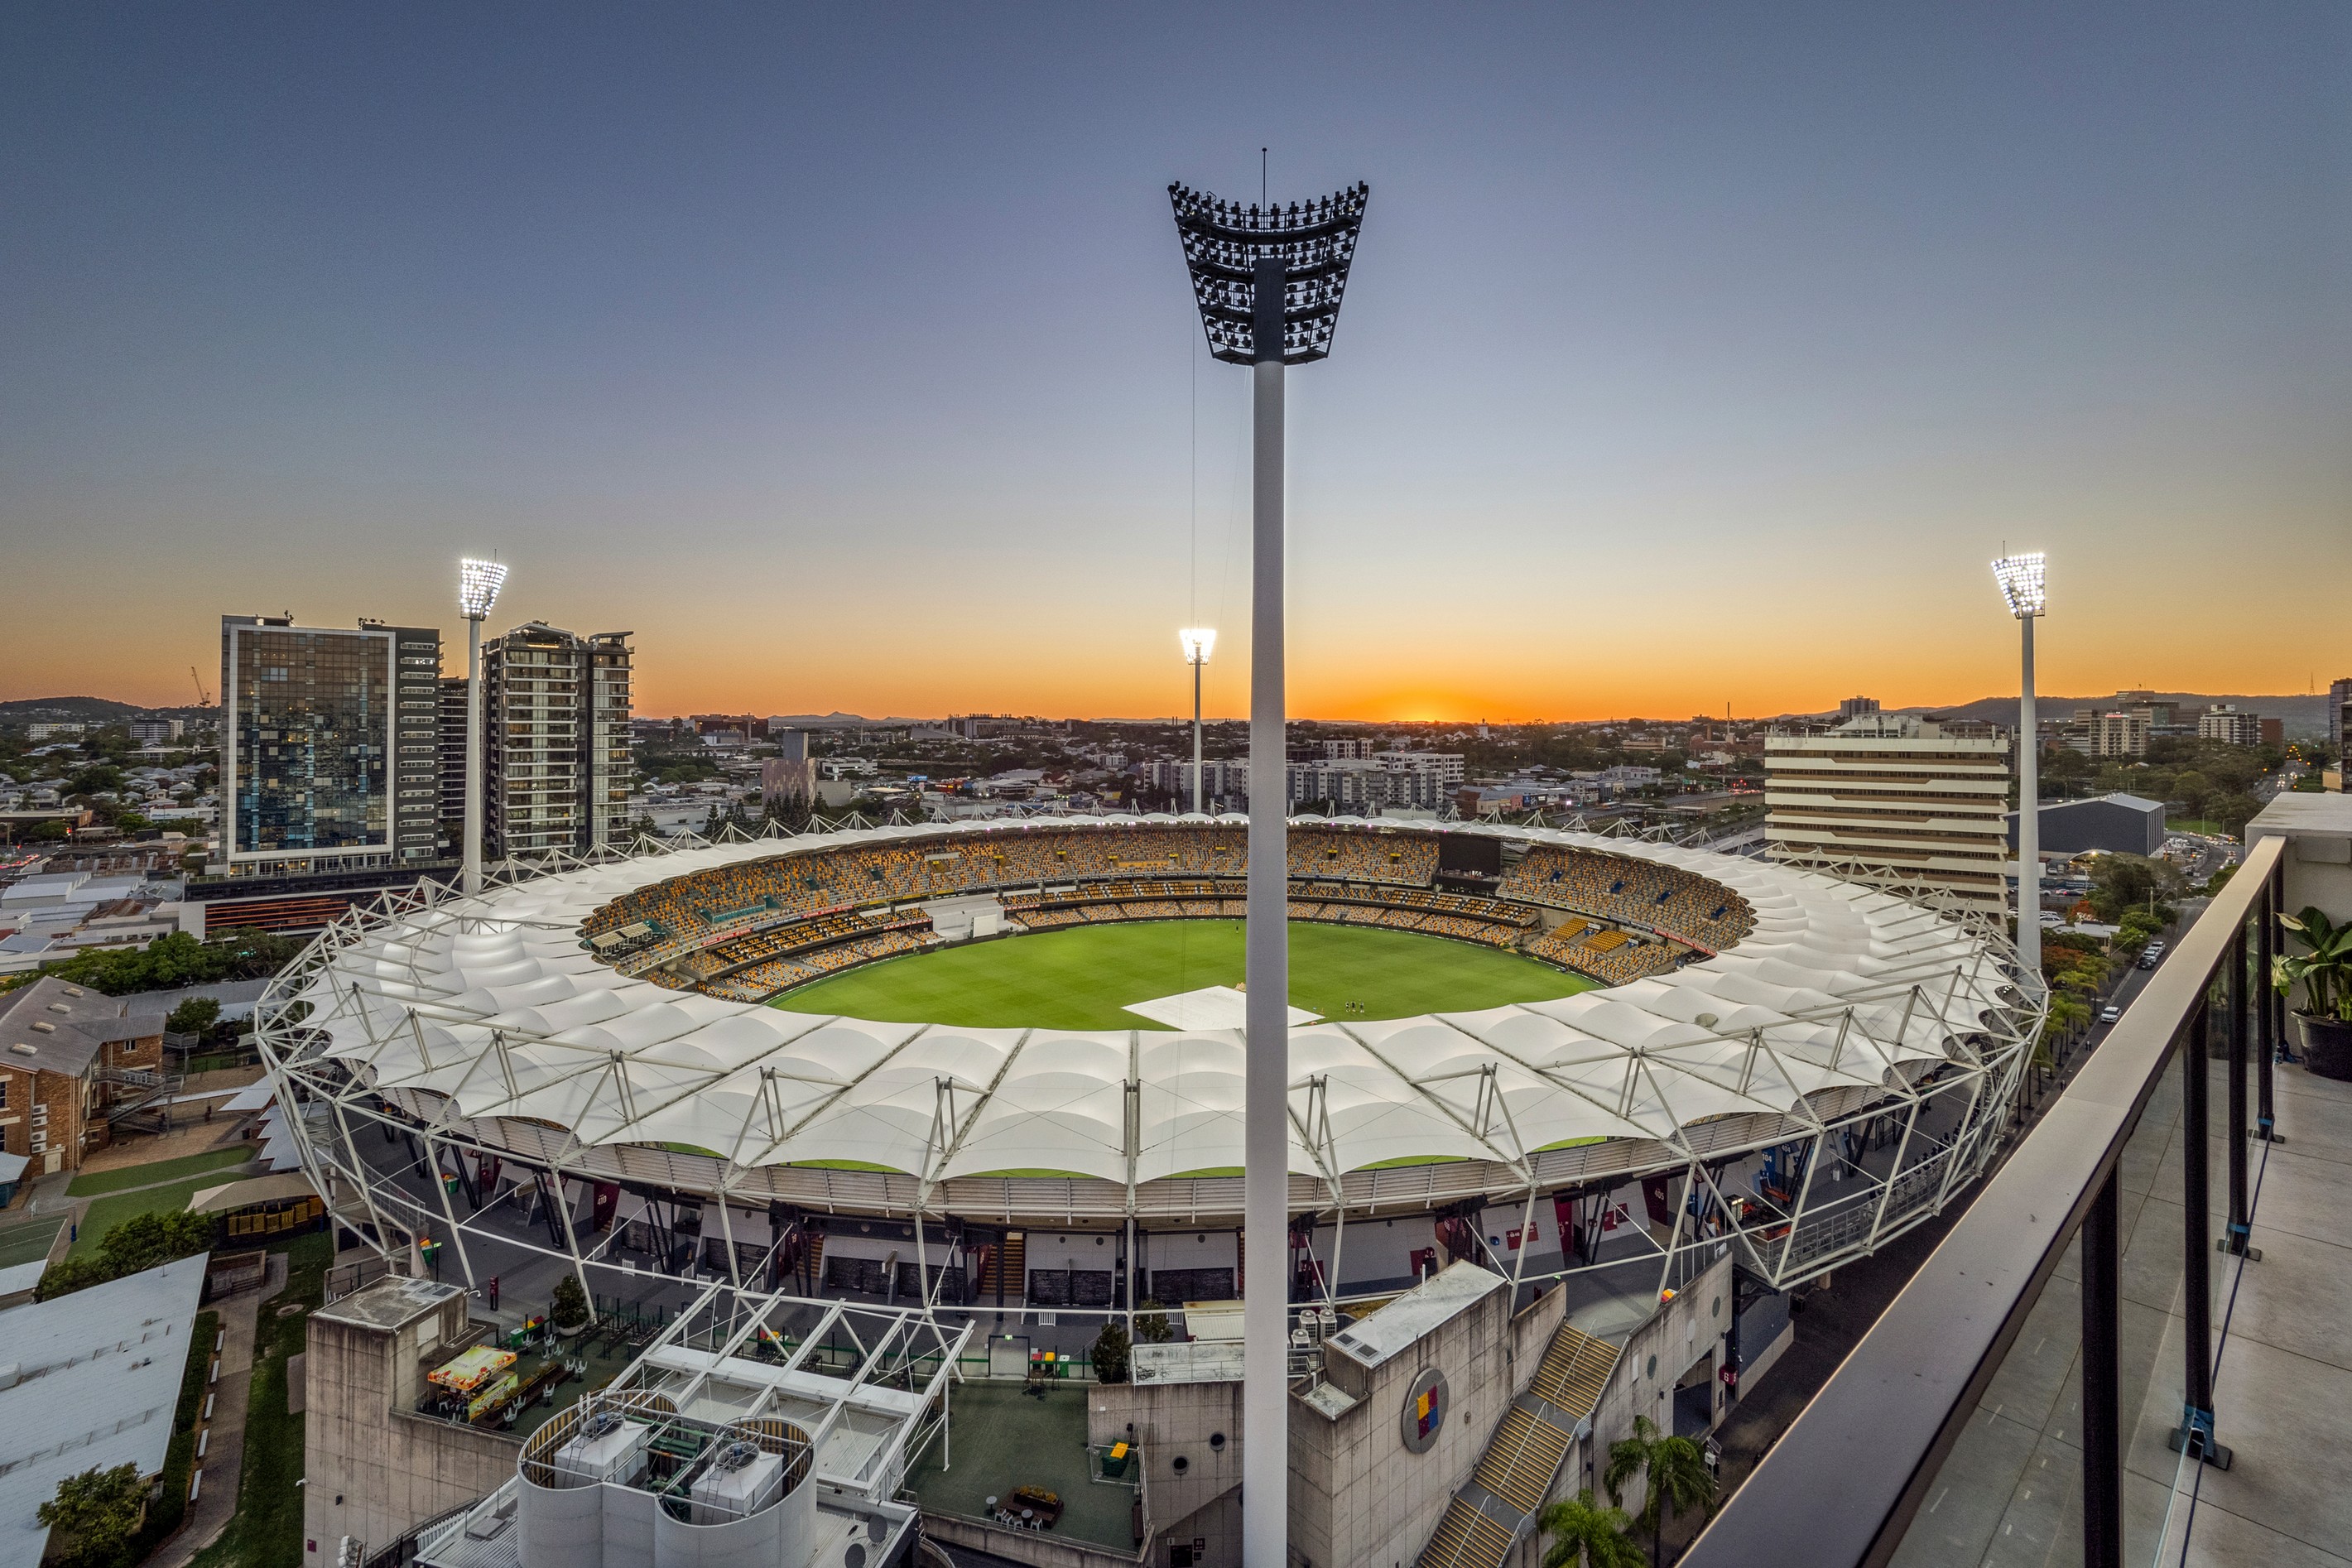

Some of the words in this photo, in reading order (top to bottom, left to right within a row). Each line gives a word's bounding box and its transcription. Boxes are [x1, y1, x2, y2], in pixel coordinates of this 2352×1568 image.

[1654, 1189, 1665, 1200] 405
[597, 1195, 607, 1205] 410
[1724, 1373, 1729, 1382] 6
